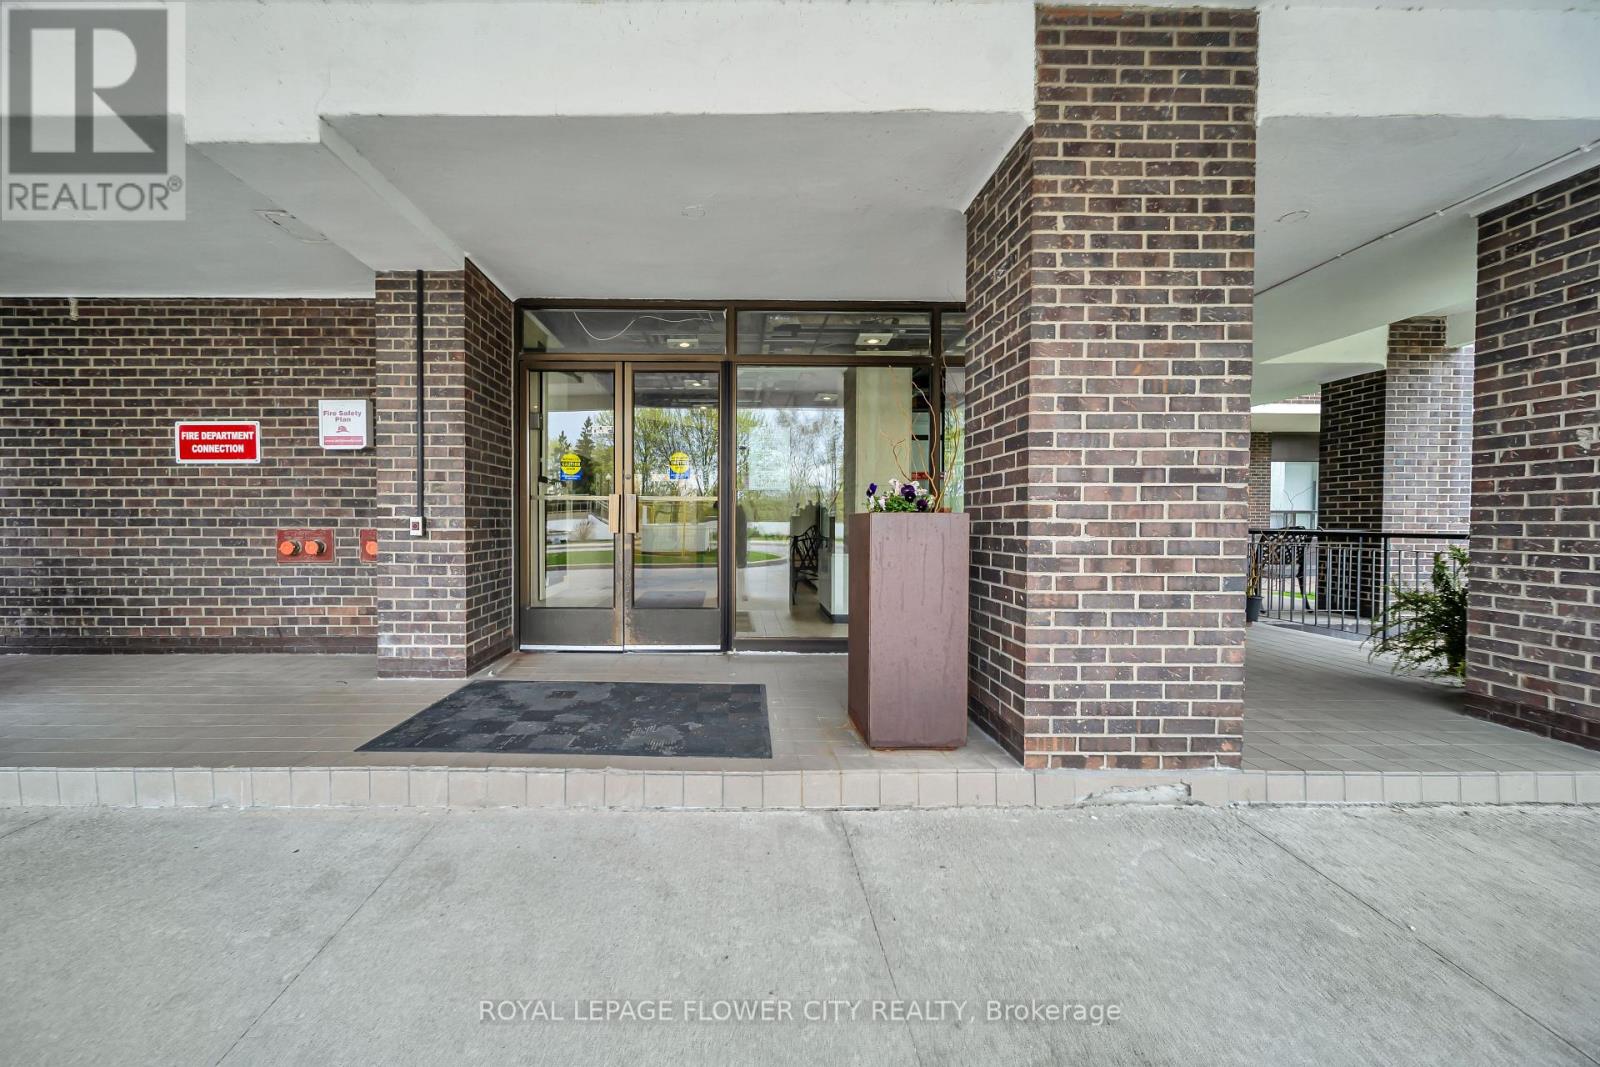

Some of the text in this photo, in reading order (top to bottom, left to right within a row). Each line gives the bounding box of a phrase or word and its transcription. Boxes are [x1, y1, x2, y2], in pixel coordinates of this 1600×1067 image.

[181, 431, 254, 440] FIRE DEPARTMENT
[191, 444, 244, 453] CONNECTION
